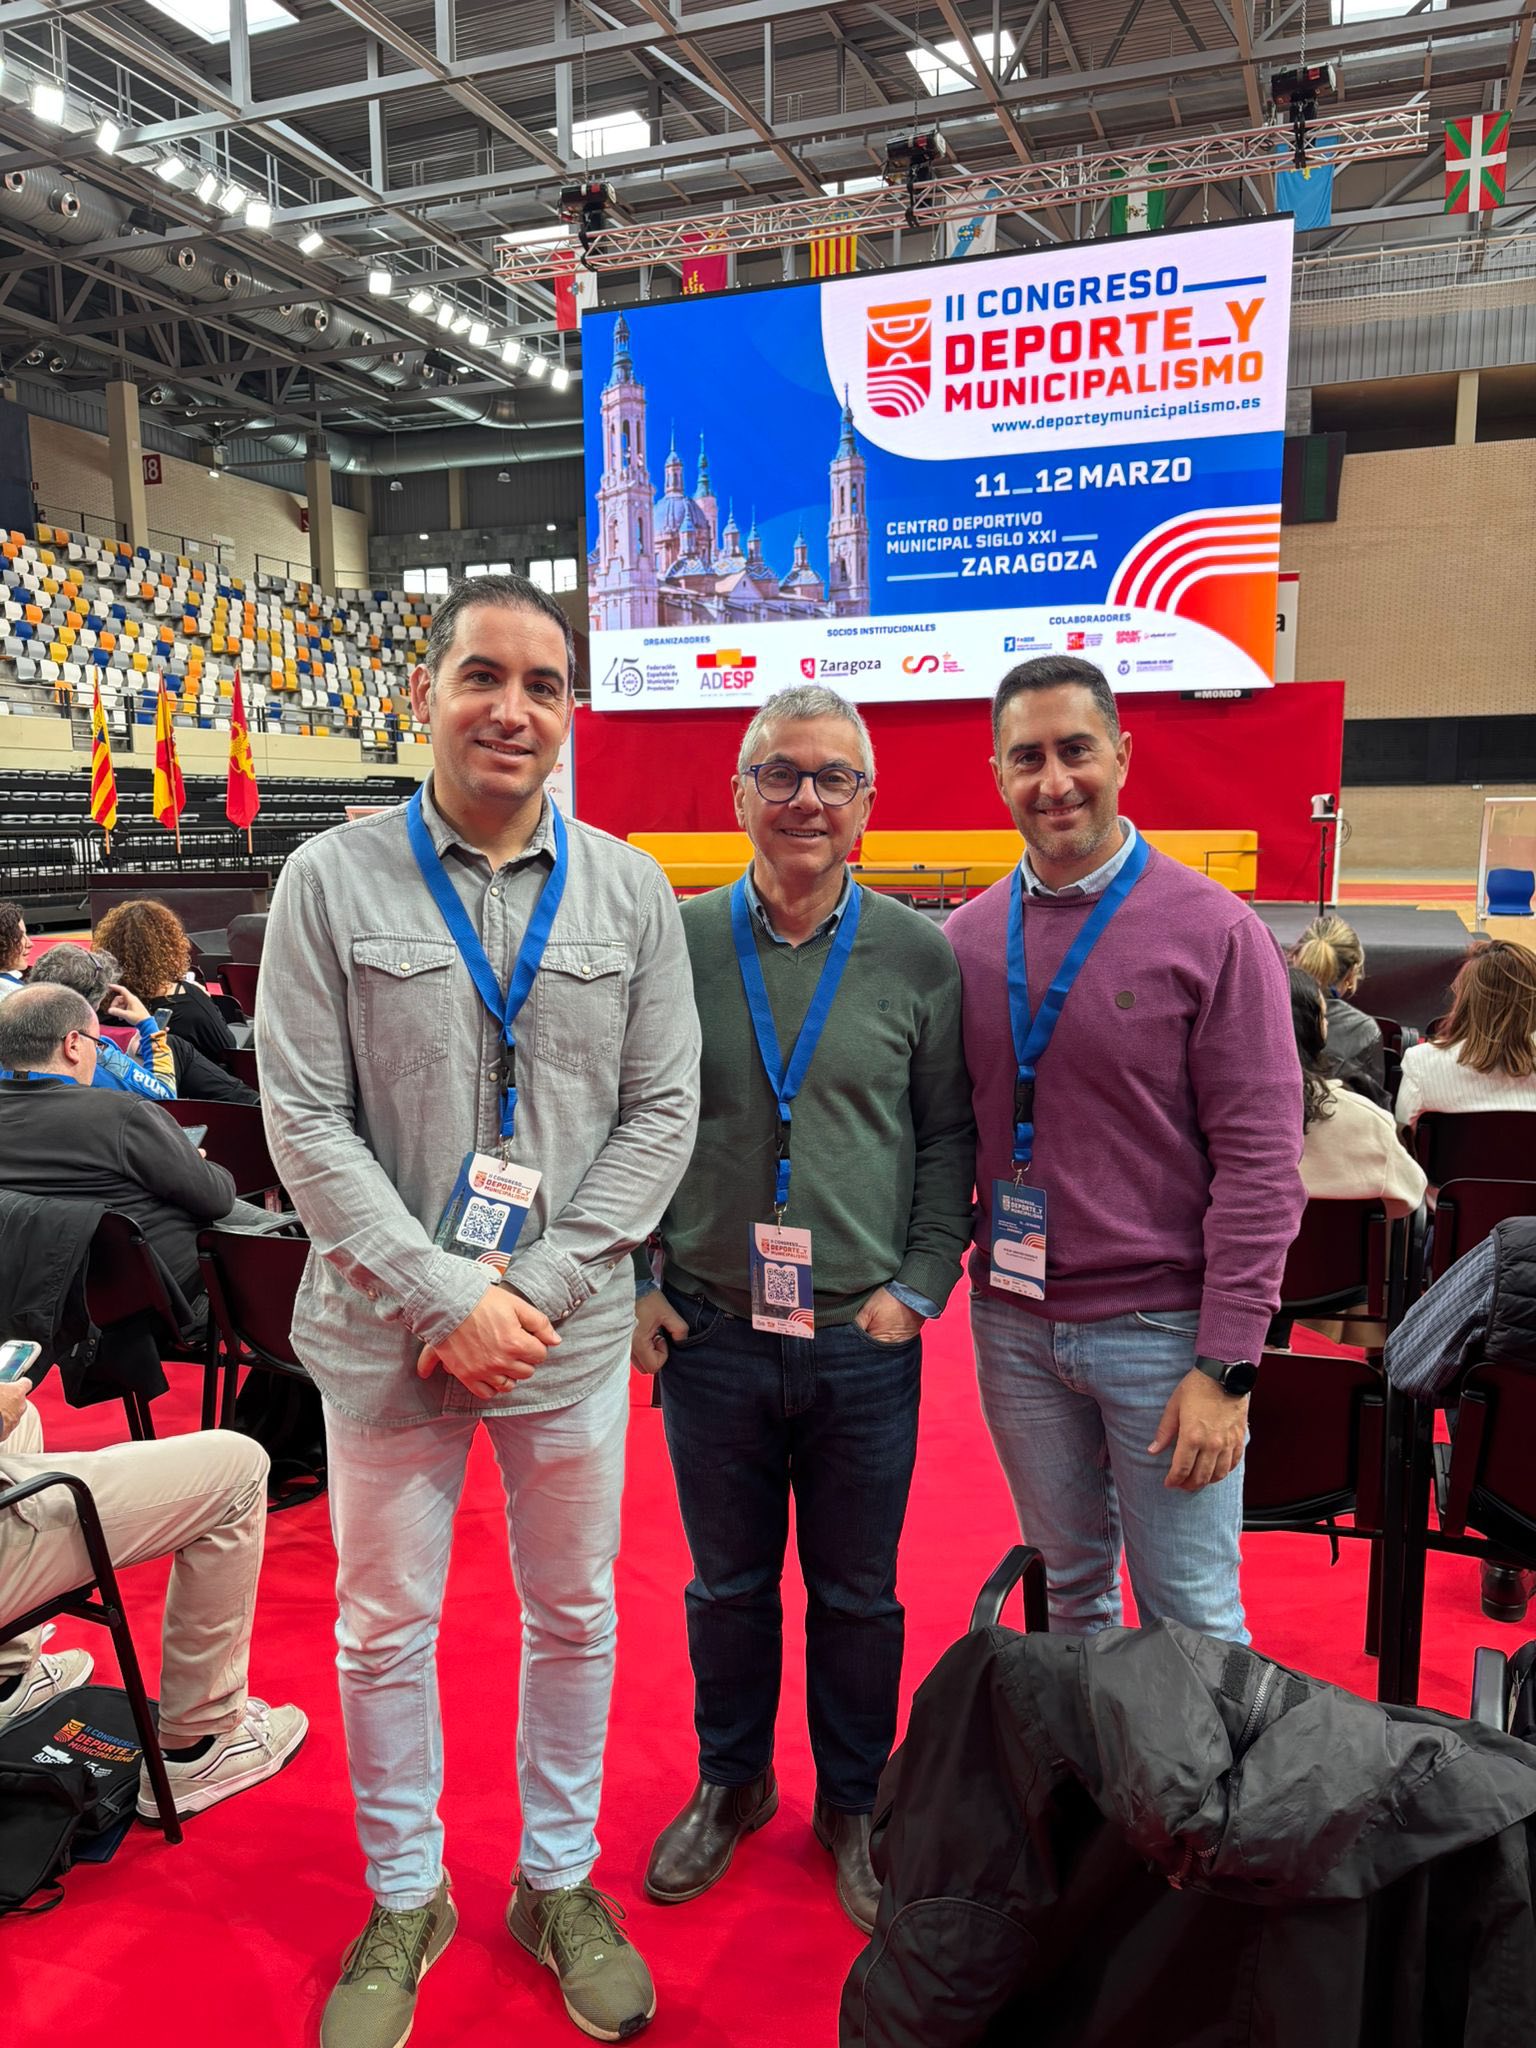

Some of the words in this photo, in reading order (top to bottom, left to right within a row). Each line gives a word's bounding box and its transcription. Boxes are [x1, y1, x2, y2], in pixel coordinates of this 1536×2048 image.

[946, 294, 964, 322] II
[977, 266, 1178, 319] CONGRESO
[944, 351, 1263, 412] MUNICIPALISMO
[992, 398, 1261, 433] www.deporteymunicipalismo.es
[144, 458, 159, 481] 18
[1079, 457, 1192, 490] MARZO
[886, 517, 948, 536] CENTRO
[952, 511, 1043, 532] DEPORTIVO
[886, 535, 972, 554] MUNICIPAL
[976, 532, 1024, 548] SIGLO
[1028, 530, 1056, 544] XXI
[962, 550, 1098, 577] ZARAGOZA
[827, 628, 858, 636] SOCIOS
[860, 624, 936, 634] INSTITUCIONALES
[1049, 613, 1132, 625] COLABORADORES
[644, 636, 710, 646] ORGANIZADORES
[820, 659, 882, 675] Zaragoza
[700, 670, 754, 690] ADESP
[1202, 690, 1242, 699] MONDO
[68, 1742, 134, 1763] MUNICIPALISMO
